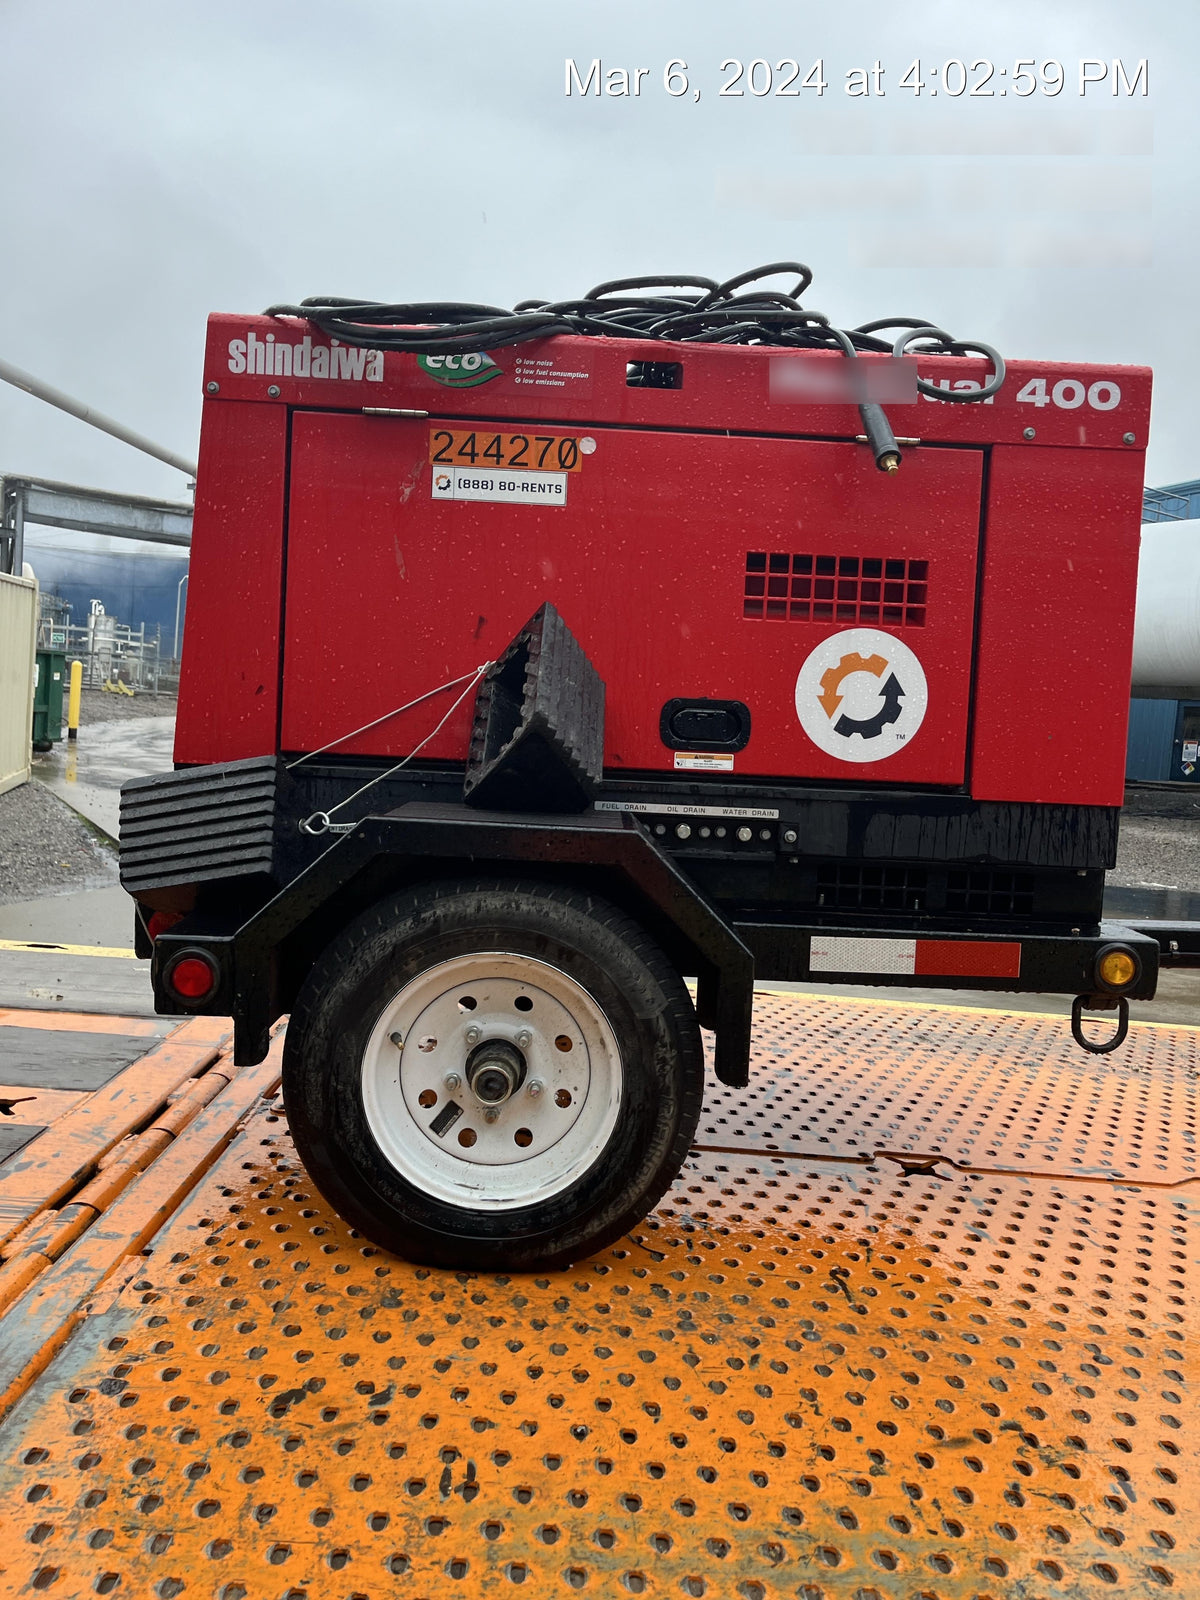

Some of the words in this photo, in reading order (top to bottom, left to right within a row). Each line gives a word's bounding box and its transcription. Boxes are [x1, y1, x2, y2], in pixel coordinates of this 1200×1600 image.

[228, 332, 384, 382] shindaiwa
[425, 352, 482, 371] eco
[523, 358, 535, 366] low
[549, 370, 589, 379] consumption
[522, 377, 534, 385] low
[535, 378, 566, 387] emissions
[916, 374, 995, 405] ual
[1015, 378, 1122, 411] 400
[432, 431, 577, 470] 244270
[457, 477, 494, 491] (888)
[498, 480, 563, 494] 80-RENTS
[601, 802, 620, 810] FUEL
[683, 806, 706, 814] DRAIN
[722, 808, 748, 816] WATER
[751, 809, 775, 817] DRAIN
